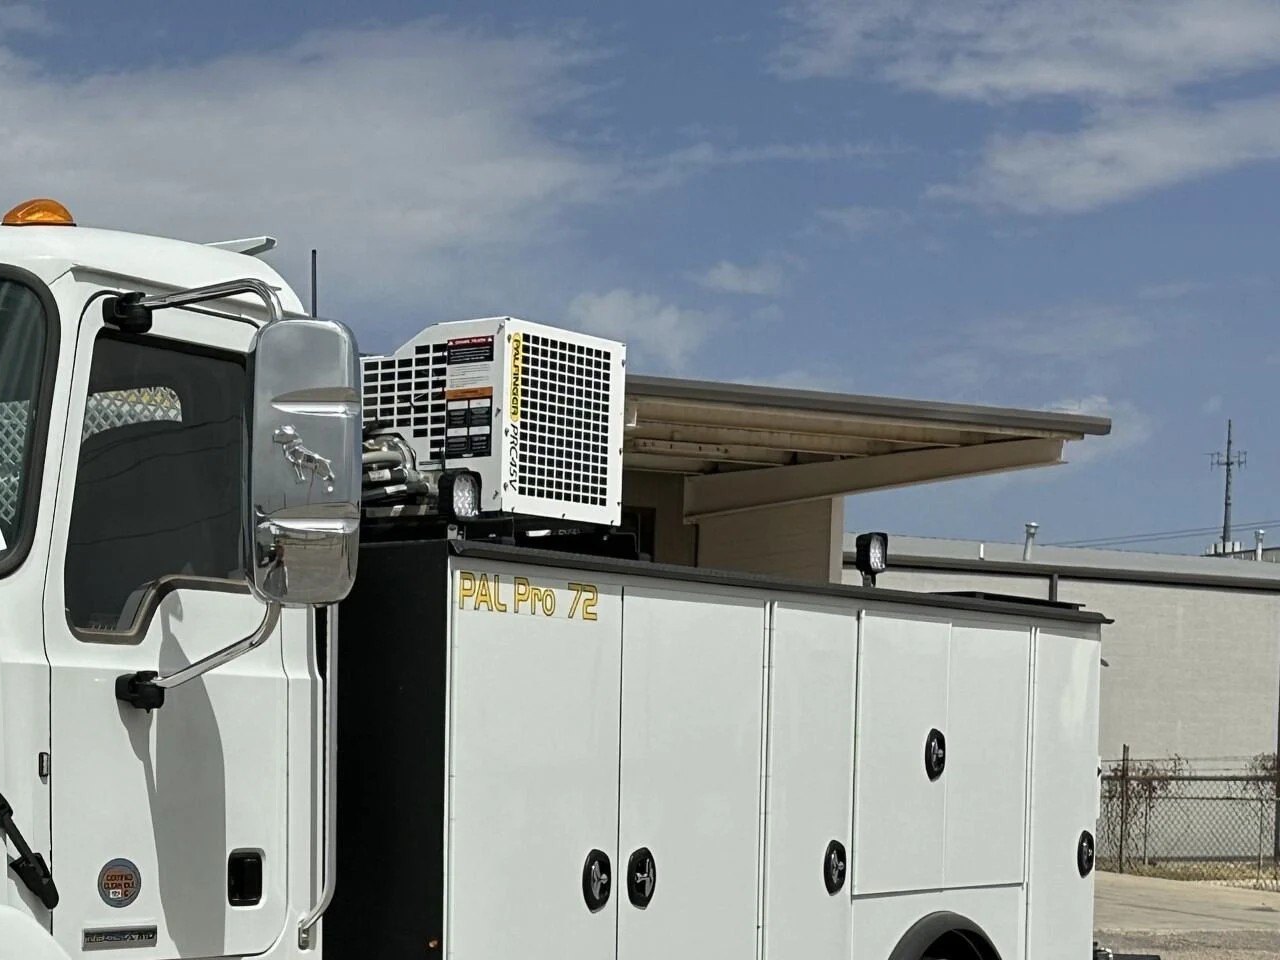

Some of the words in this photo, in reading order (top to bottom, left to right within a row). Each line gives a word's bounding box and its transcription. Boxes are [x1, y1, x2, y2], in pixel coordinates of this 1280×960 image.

[510, 338, 520, 416] PALFINGER
[458, 571, 508, 612] PAL
[513, 576, 556, 617] Pro
[567, 582, 599, 621] 72
